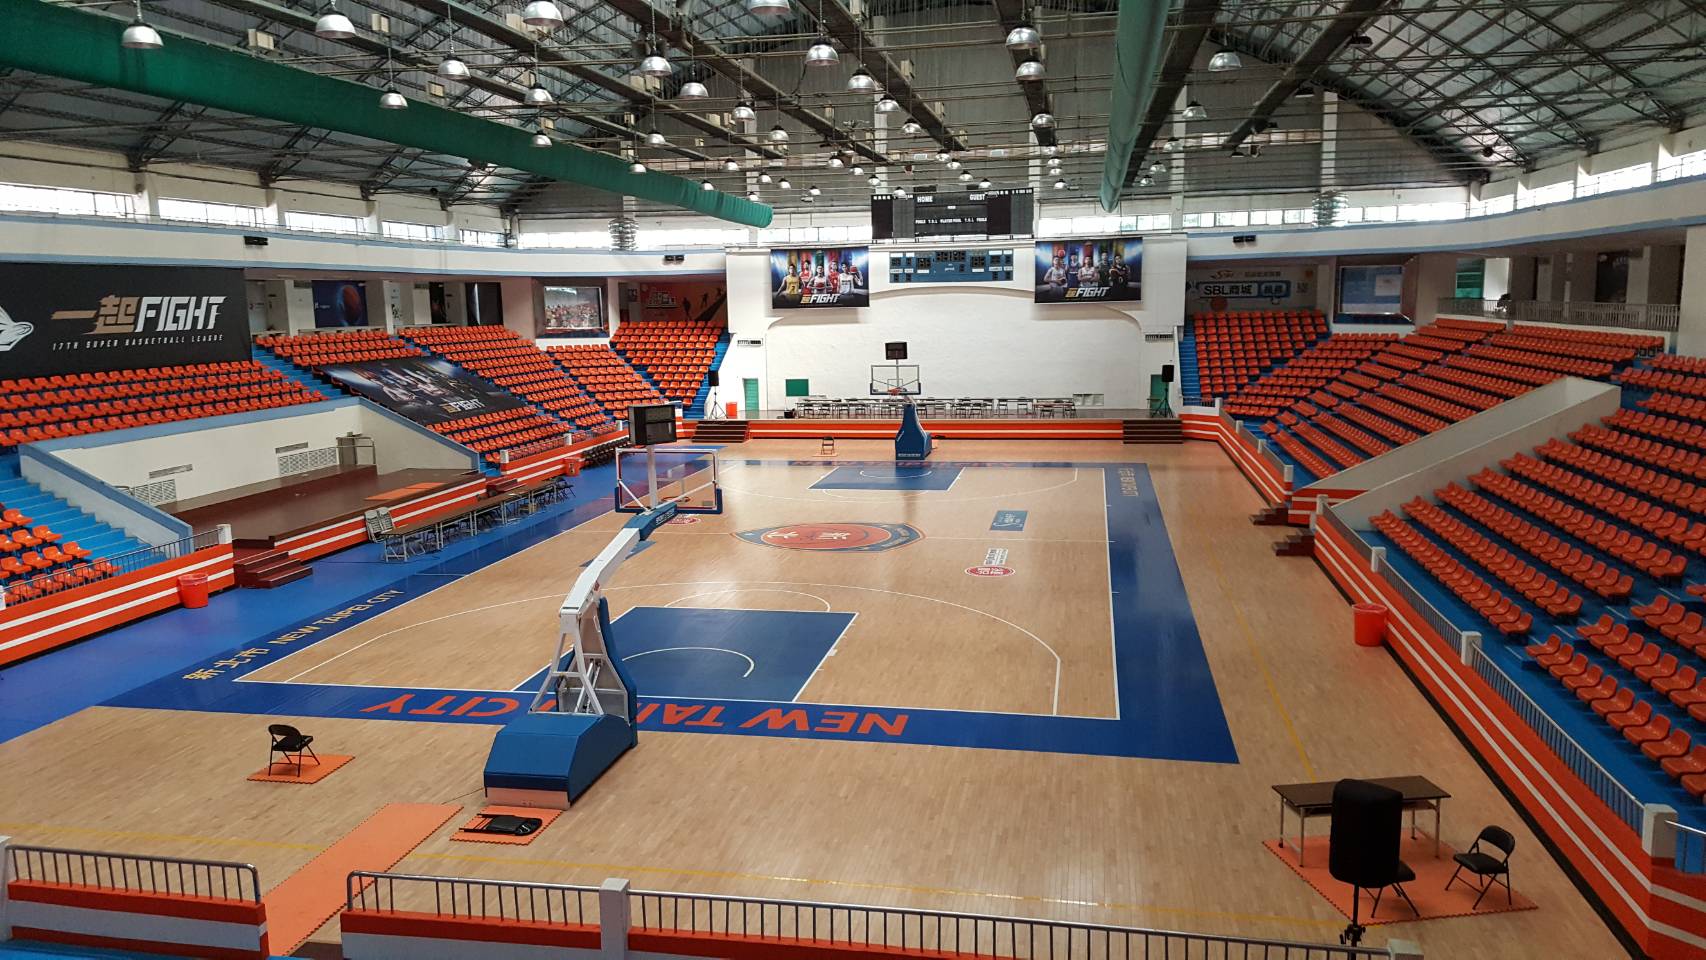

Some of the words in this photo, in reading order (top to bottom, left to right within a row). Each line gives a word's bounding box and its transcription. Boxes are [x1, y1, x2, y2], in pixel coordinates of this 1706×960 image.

[917, 195, 933, 203] HOME
[969, 193, 986, 201] GUEST
[52, 341, 79, 351] 17TH
[86, 339, 118, 349] SUPER
[125, 336, 185, 346] BASKETBALL
[191, 334, 223, 343] LEAGUE
[182, 647, 271, 680] 新北市
[267, 625, 321, 645] NEW
[313, 603, 372, 625] TAIPEI
[366, 590, 404, 605] CITY
[360, 693, 520, 717] CITY
[739, 708, 908, 737] NEW
